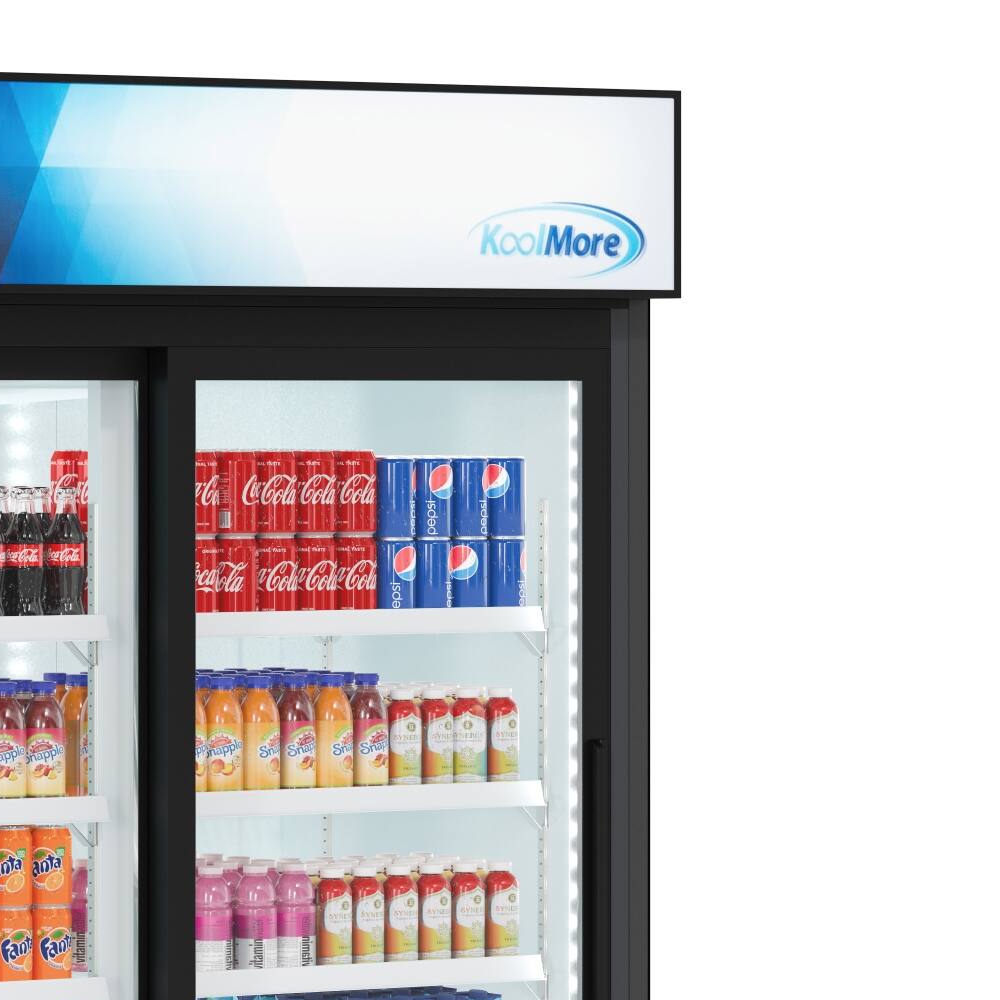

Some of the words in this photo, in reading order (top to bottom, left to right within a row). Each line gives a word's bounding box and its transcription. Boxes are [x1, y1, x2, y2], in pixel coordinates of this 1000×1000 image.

[480, 223, 621, 257] KoolMore
[426, 500, 438, 535] pepsi
[480, 500, 488, 534] pepsi
[390, 582, 403, 608] epsi
[518, 580, 526, 607] epsi
[32, 854, 61, 878] anta
